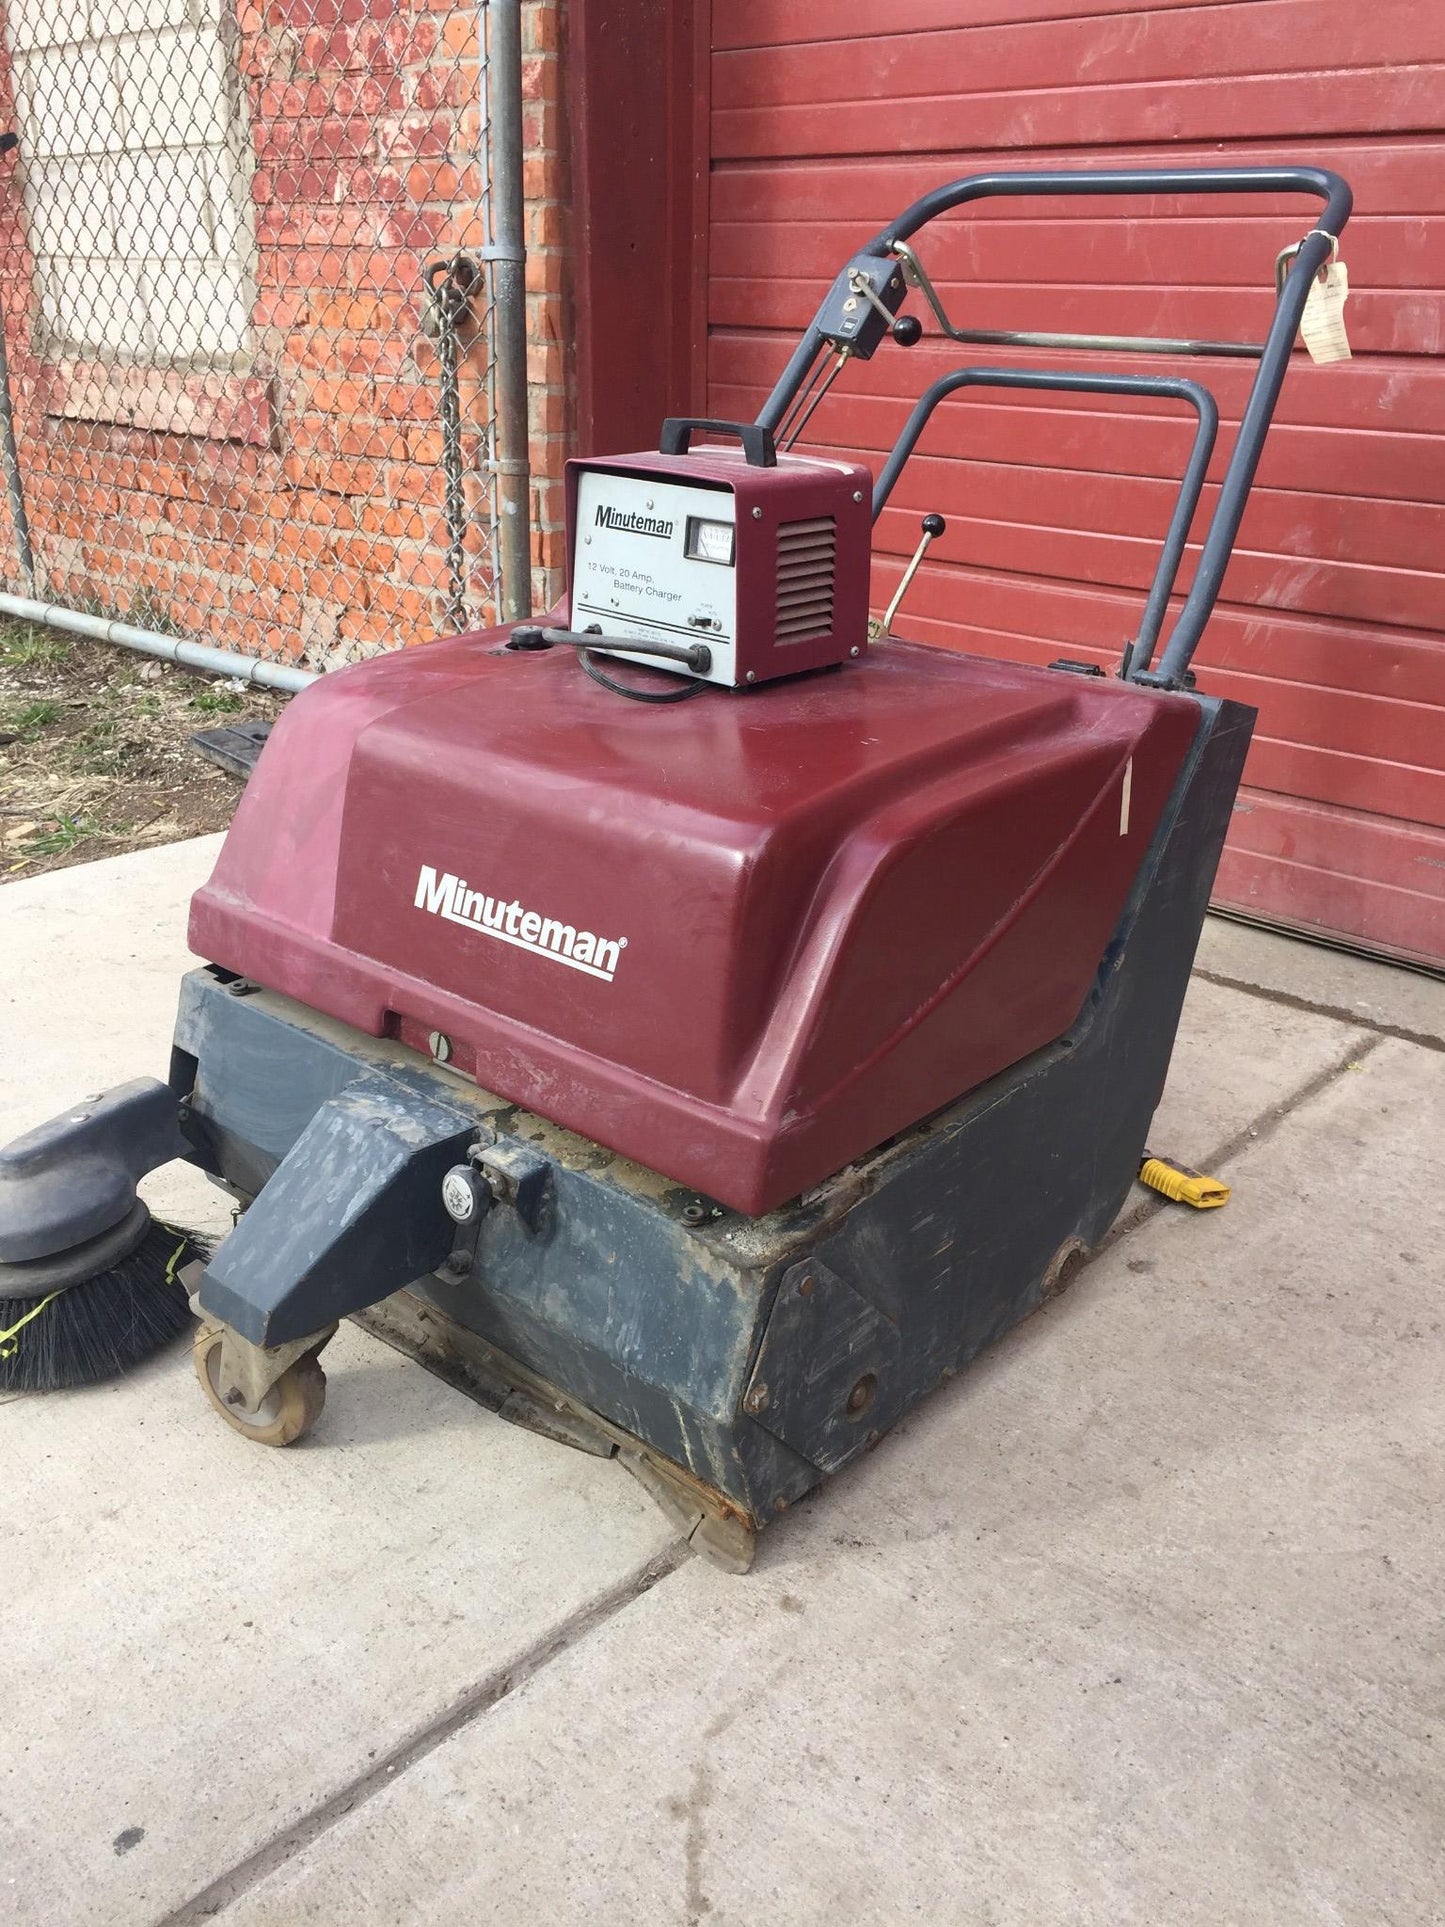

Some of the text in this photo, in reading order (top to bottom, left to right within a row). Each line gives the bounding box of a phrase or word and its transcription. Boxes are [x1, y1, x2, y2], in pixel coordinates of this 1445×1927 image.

[594, 504, 674, 536] Minuteman
[588, 562, 598, 571] 12
[619, 568, 630, 577] 20
[613, 579, 682, 601] Battery Charger
